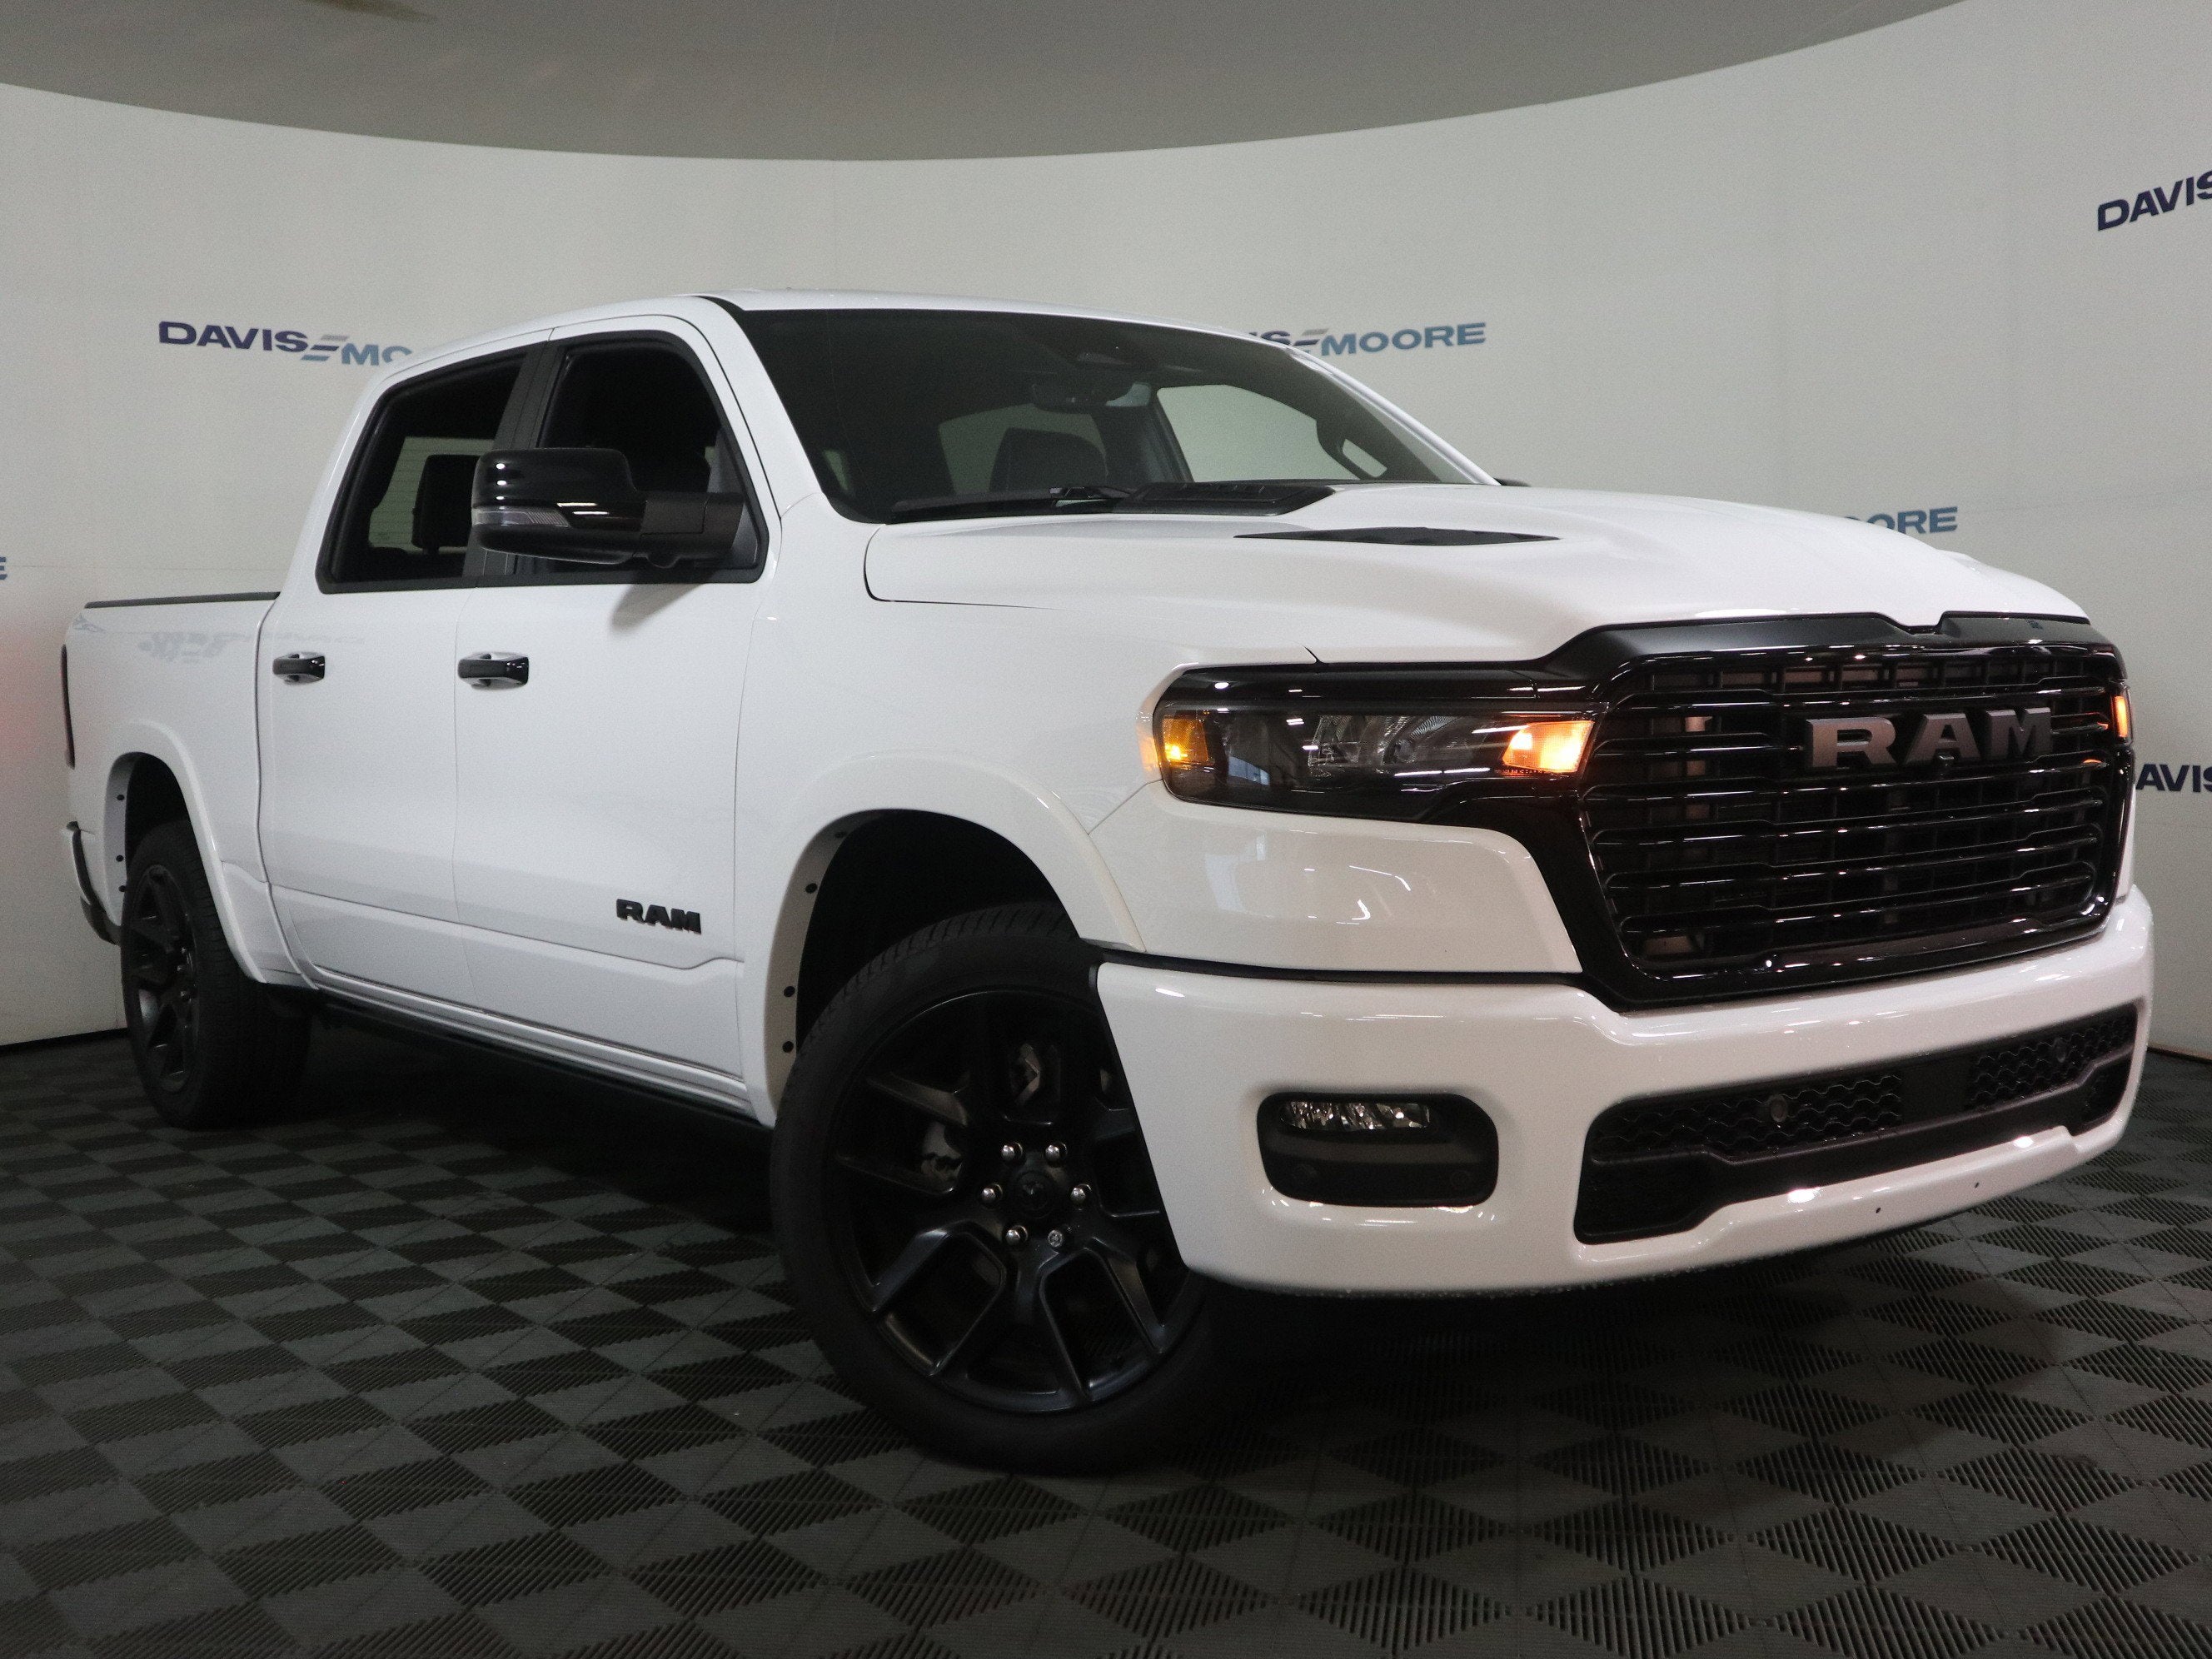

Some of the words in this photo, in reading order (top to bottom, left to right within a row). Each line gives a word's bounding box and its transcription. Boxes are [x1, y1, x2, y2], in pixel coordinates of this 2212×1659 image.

[158, 321, 308, 352] DAVIS
[1321, 322, 1487, 356] MOORE
[1806, 707, 2052, 768] RAM
[616, 899, 701, 934] RAM
